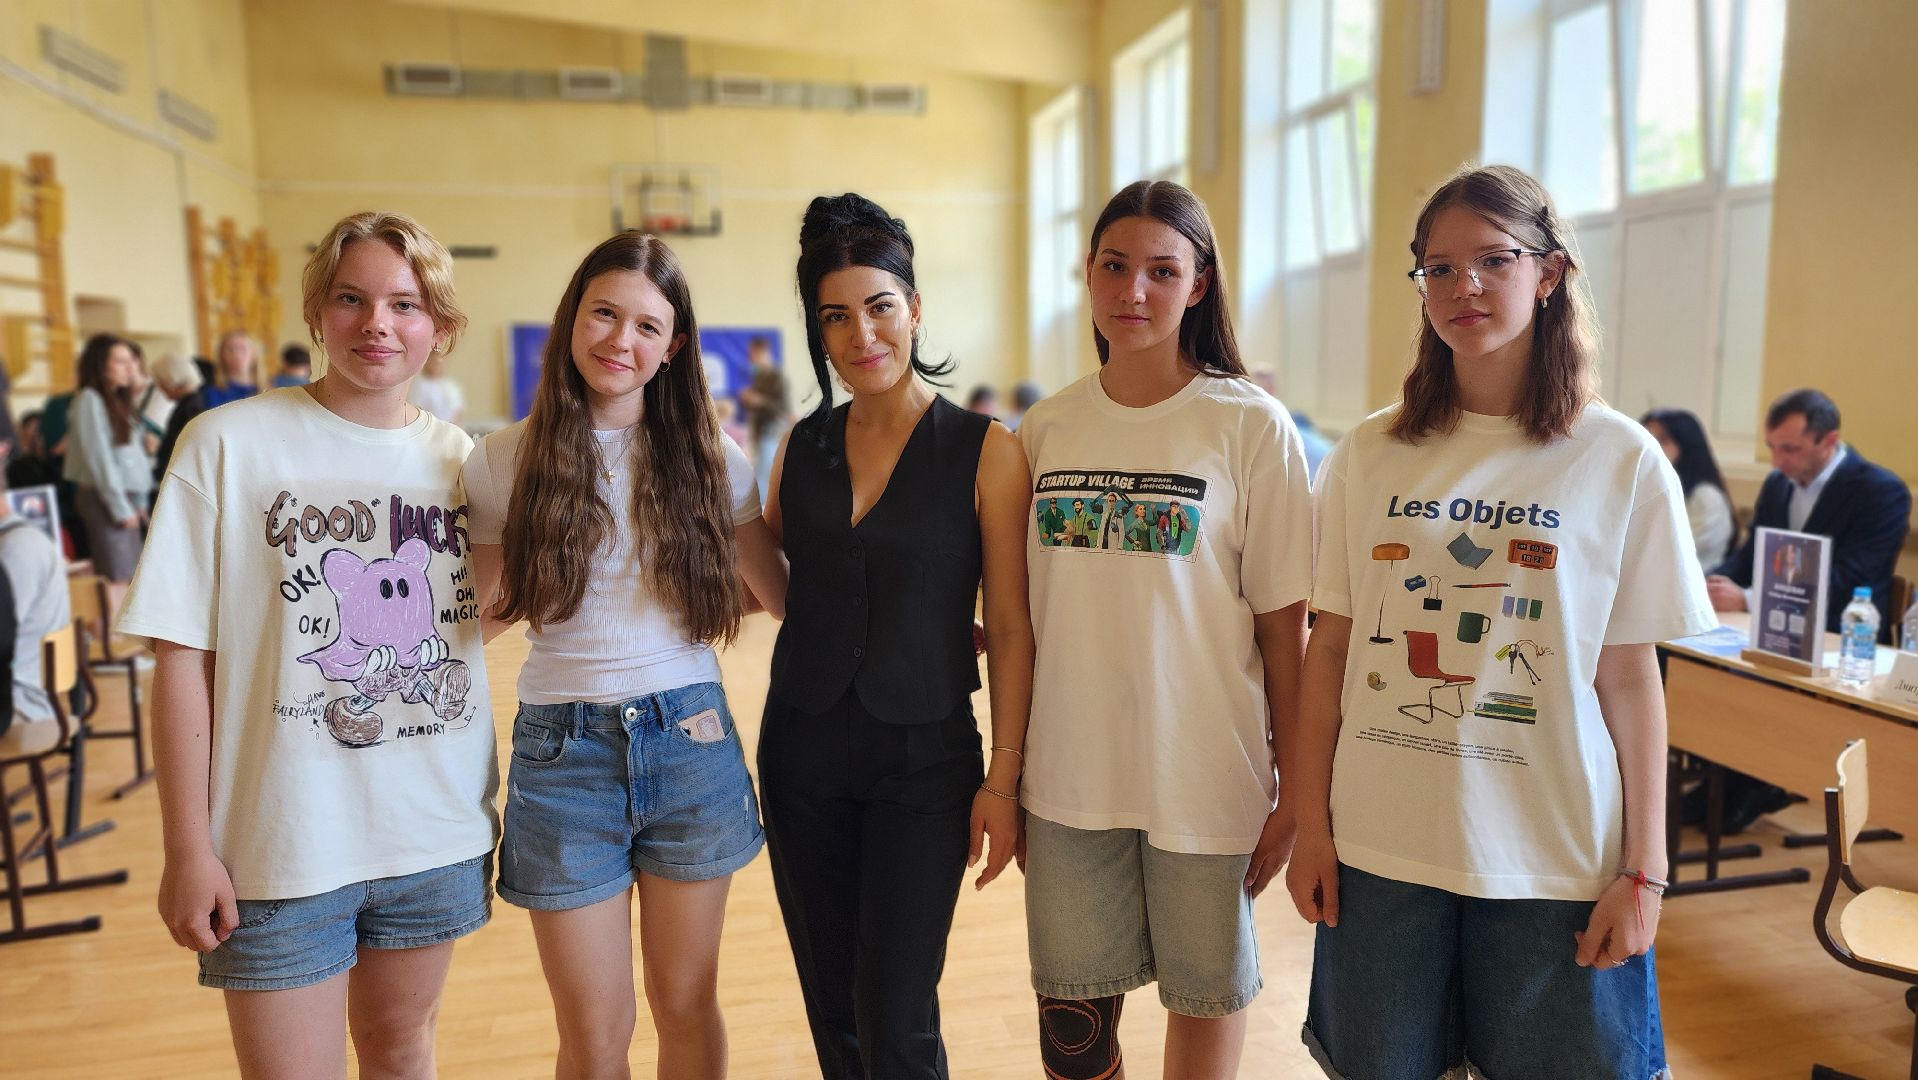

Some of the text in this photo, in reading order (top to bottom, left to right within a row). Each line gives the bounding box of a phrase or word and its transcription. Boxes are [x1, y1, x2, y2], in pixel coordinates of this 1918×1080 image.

[1039, 474, 1136, 490] STARTUP VILLAGE
[1139, 483, 1199, 495] ИННОВАЦИЙ
[1387, 495, 1560, 529] Les Objets
[265, 491, 377, 557] GOOD
[280, 564, 322, 603] OK!
[440, 604, 480, 625] MAGIC
[299, 615, 331, 639] OK!
[397, 723, 445, 739] MEMORY
